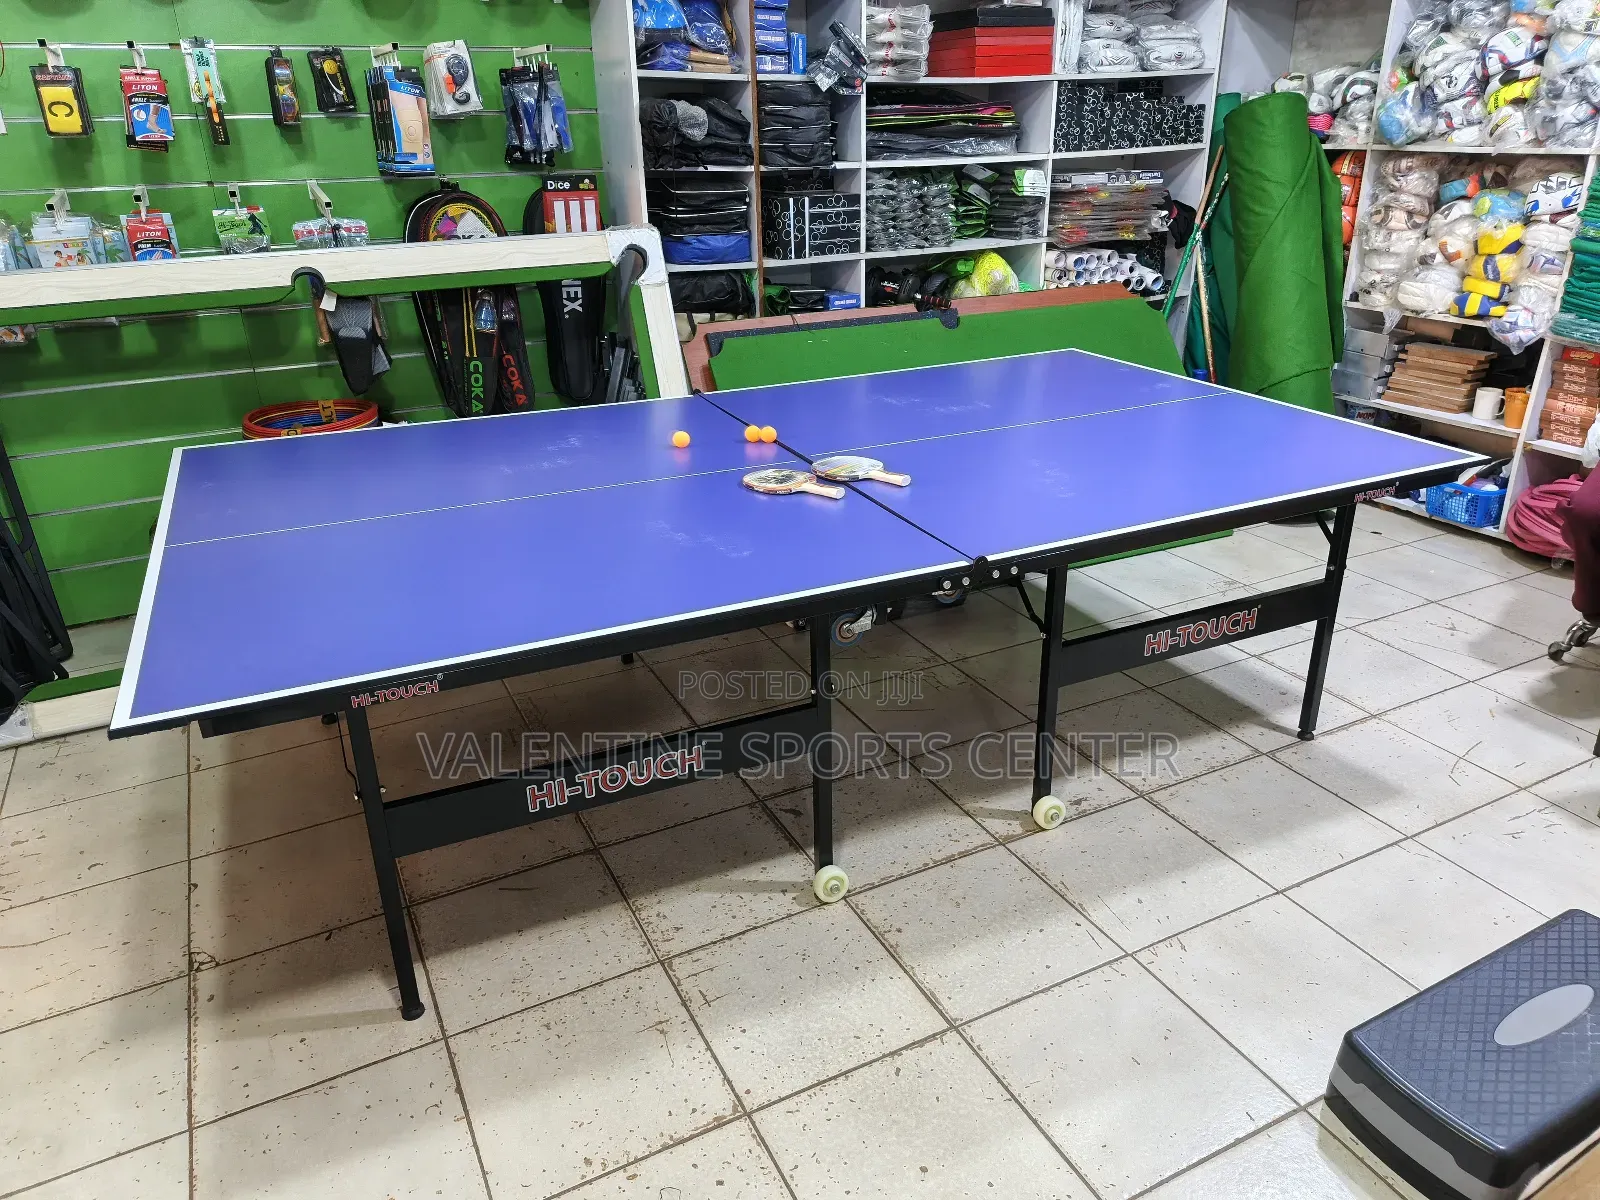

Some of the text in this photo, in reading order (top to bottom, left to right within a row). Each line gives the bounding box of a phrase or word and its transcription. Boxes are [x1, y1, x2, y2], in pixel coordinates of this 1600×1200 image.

[400, 85, 420, 94] LITON
[546, 180, 571, 190] Dice
[469, 360, 484, 413] COKA
[502, 354, 528, 406] COKA
[1354, 486, 1396, 503] HI-TOUCH
[1144, 607, 1258, 657] HI-TOUCH
[350, 679, 440, 709] HI-TOUCH
[527, 744, 704, 812] HI-TOUCH
